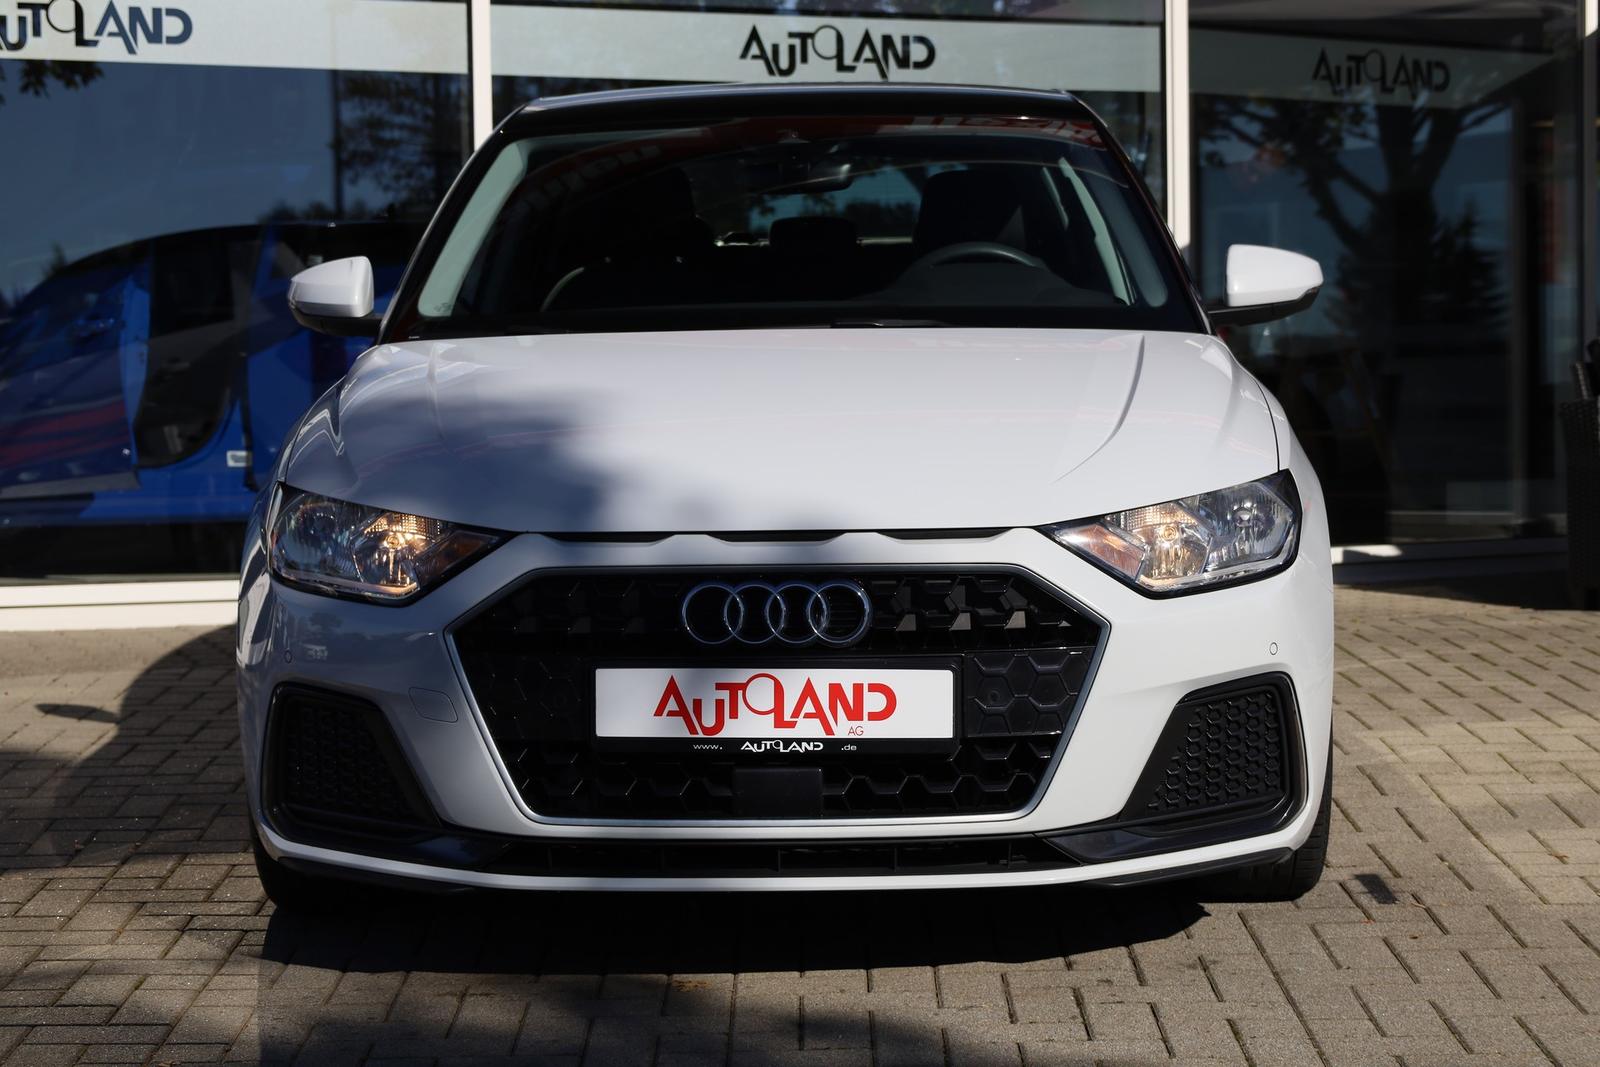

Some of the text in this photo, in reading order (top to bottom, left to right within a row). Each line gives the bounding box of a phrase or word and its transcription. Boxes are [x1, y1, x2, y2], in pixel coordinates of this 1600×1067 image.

[0, 0, 193, 55] UTOLAND
[739, 24, 936, 82] AUTOLAND
[1312, 47, 1450, 100] AUTOLAND
[653, 672, 897, 736] AUTOLAND
[847, 726, 864, 736] AG
[740, 739, 824, 753] AUTOLAND
[841, 743, 857, 751] .de
